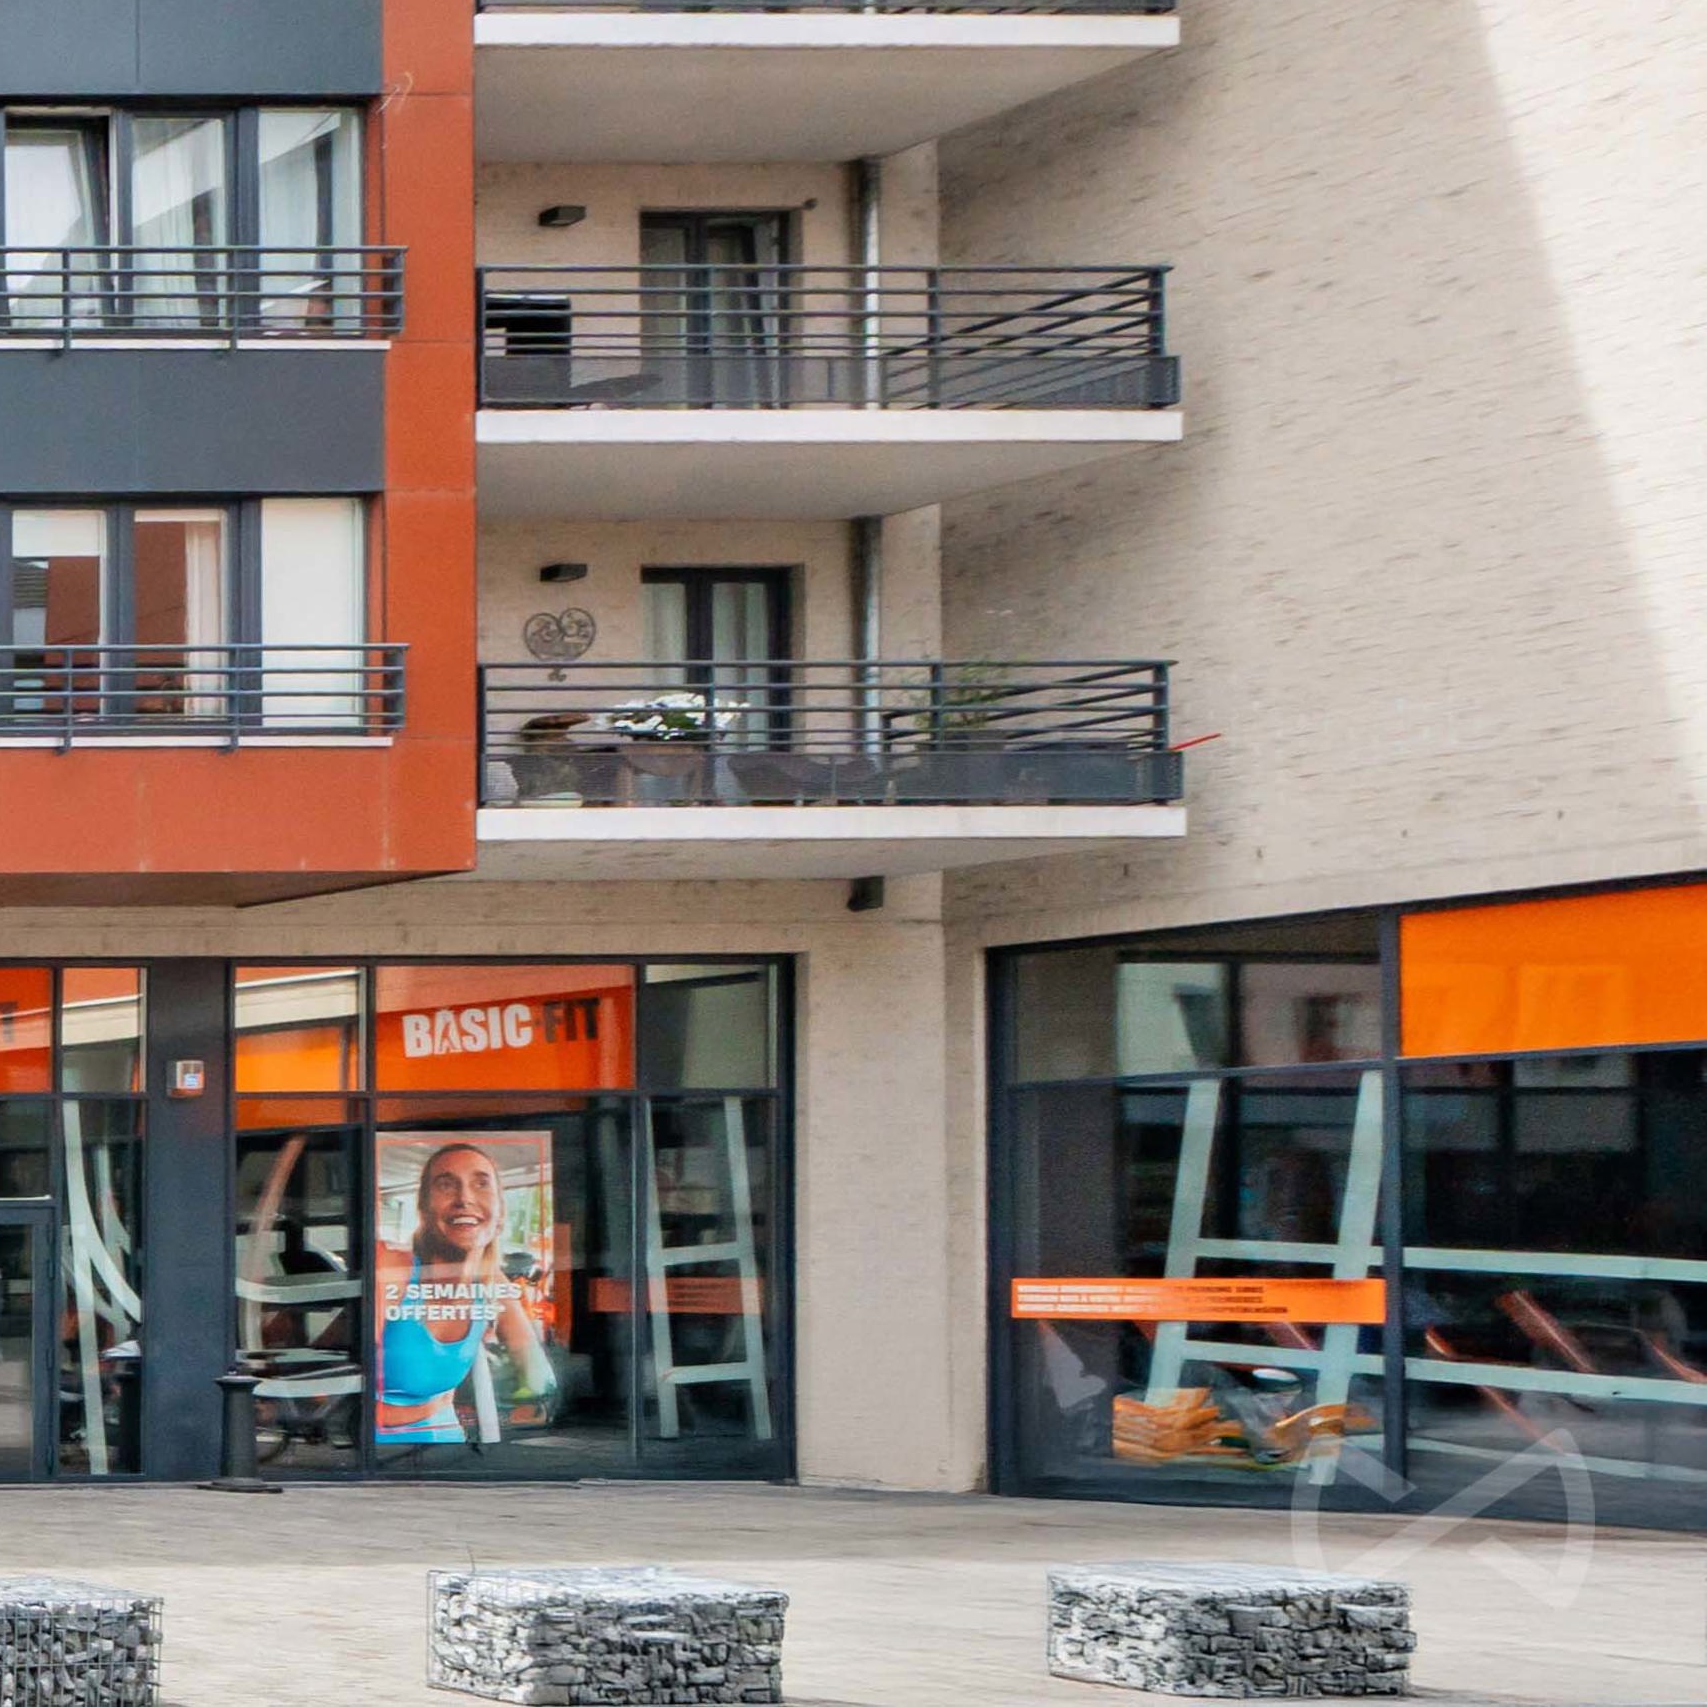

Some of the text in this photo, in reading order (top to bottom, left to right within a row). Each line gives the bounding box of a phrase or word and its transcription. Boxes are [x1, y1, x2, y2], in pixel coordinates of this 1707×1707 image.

[402, 996, 601, 1058] BASIC-FIT
[385, 1283, 522, 1300] 2 SEMAINES
